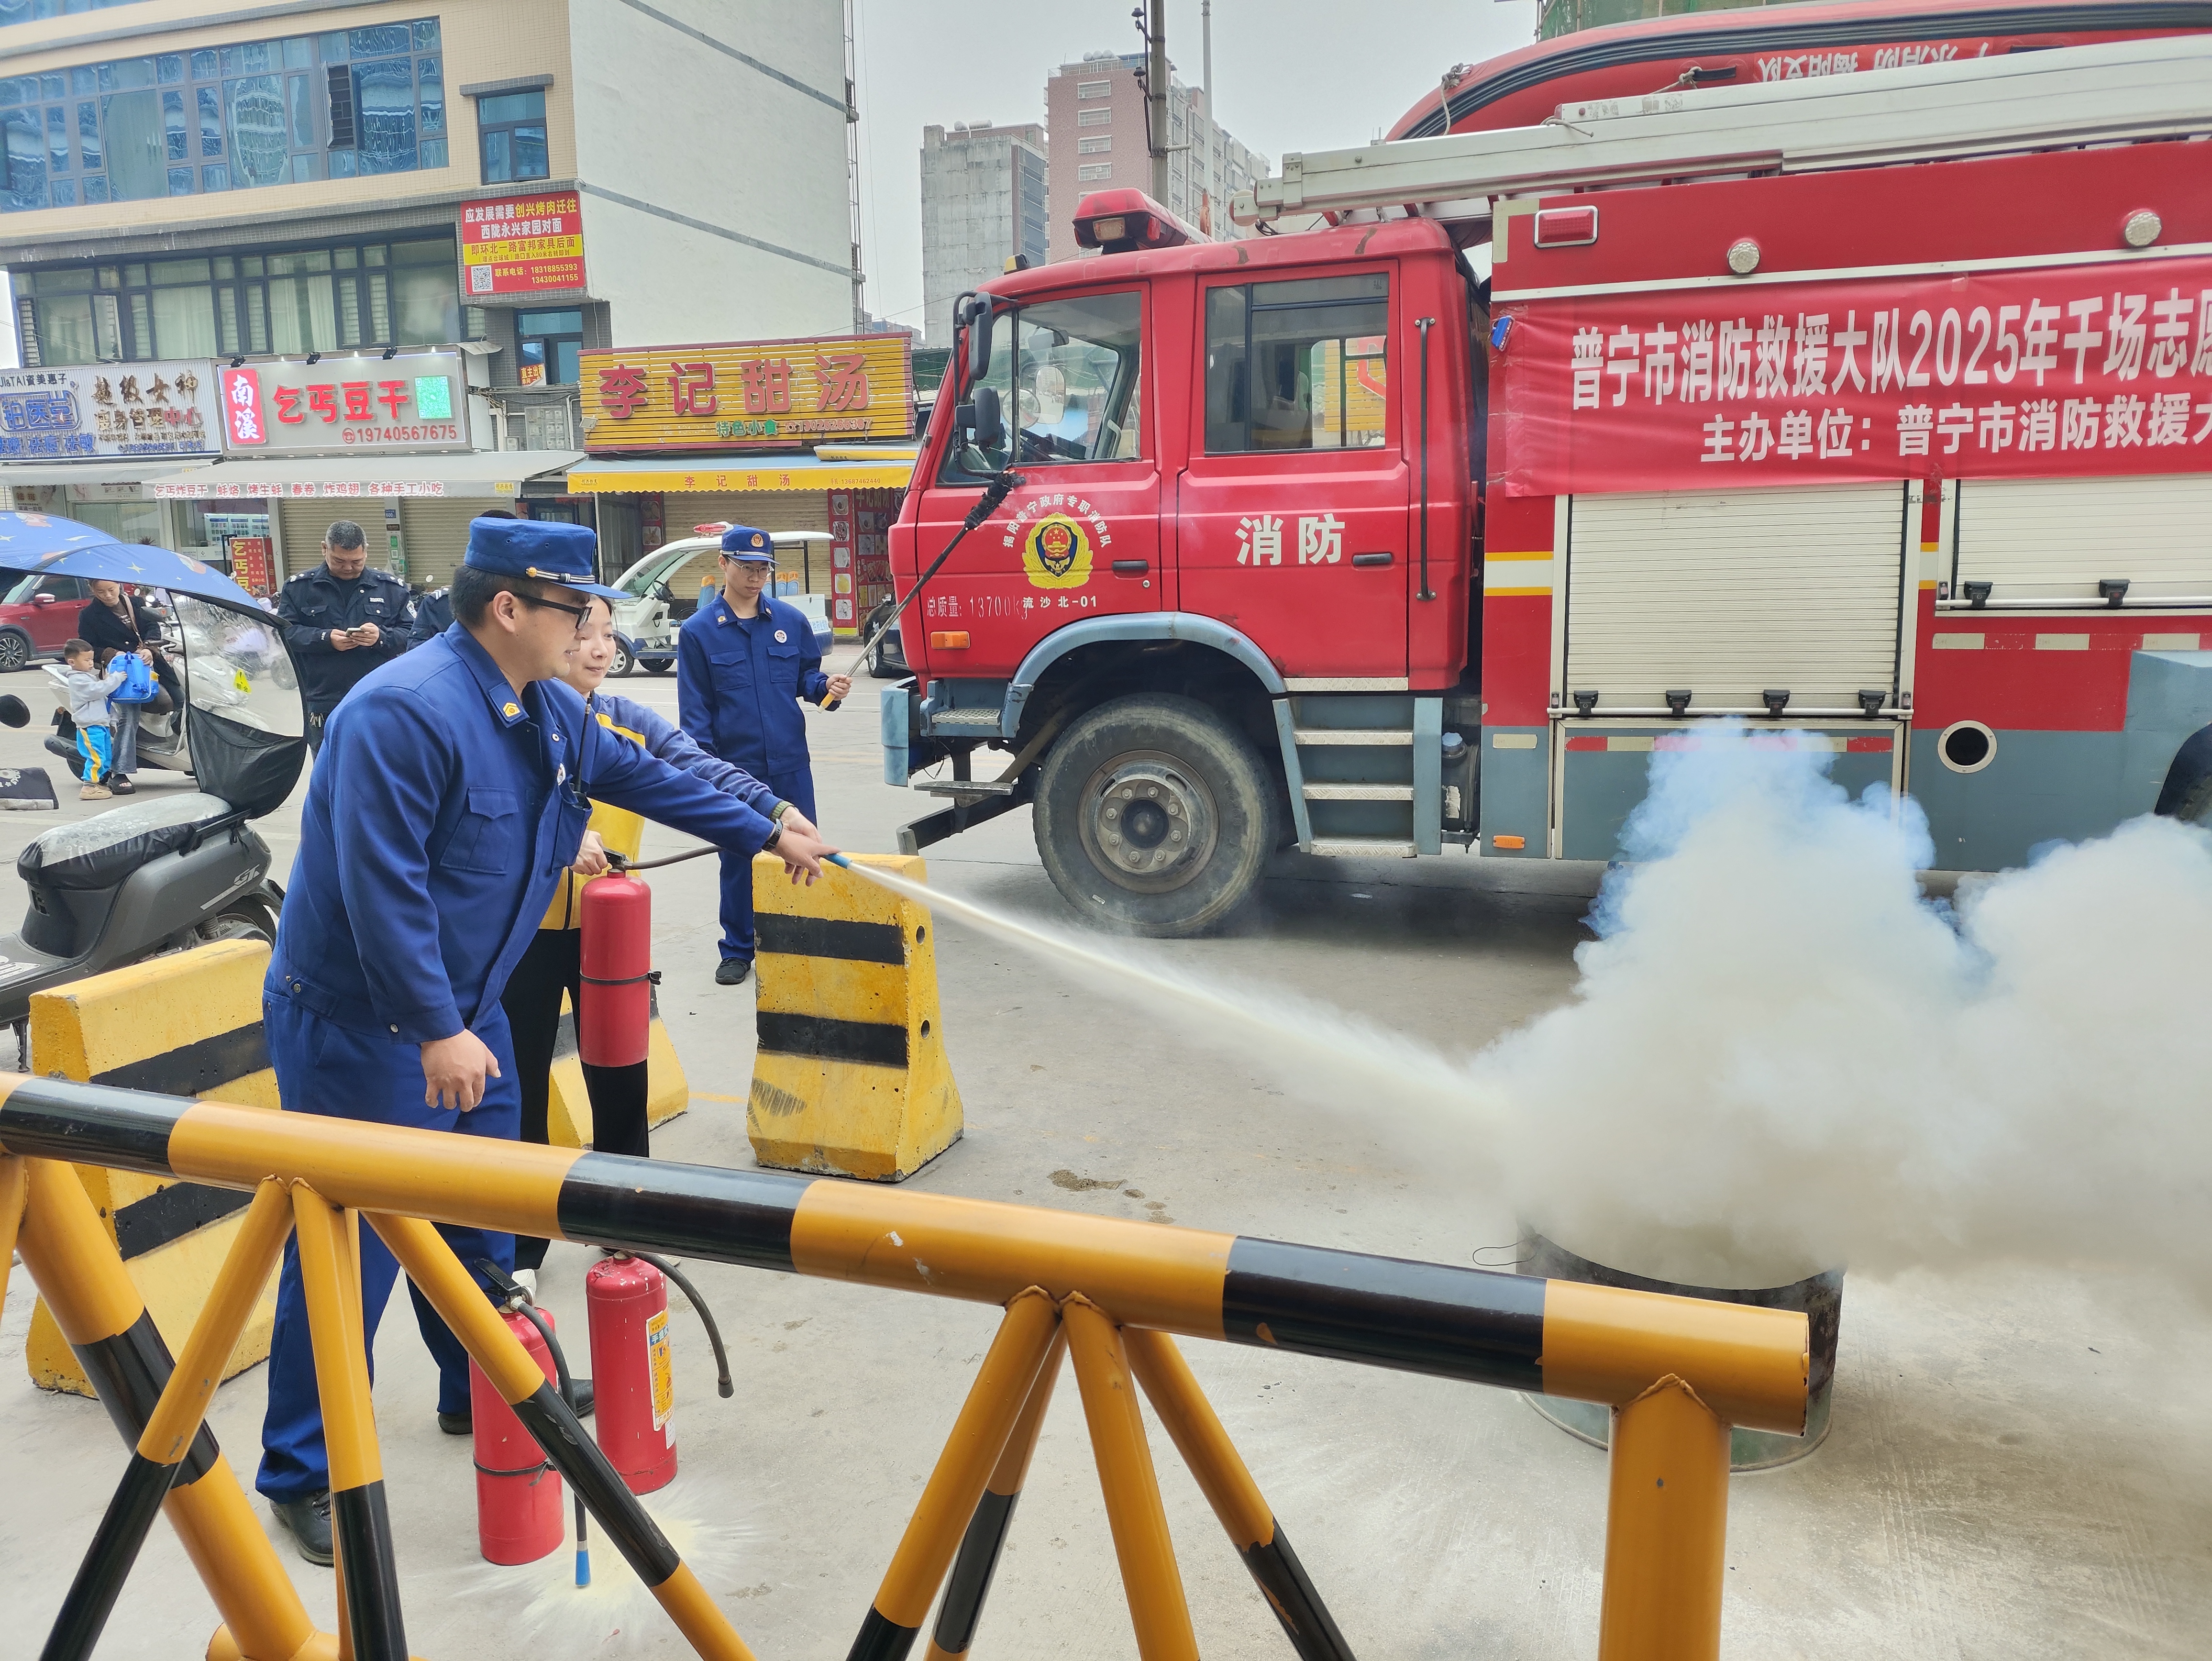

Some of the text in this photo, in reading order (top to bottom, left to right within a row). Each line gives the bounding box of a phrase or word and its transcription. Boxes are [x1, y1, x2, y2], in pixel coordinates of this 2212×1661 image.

[465, 198, 577, 223] 应发展需要创兴烤肉迁往
[481, 218, 562, 239] 西陇永兴家园对面
[471, 236, 575, 256] 即环北一路富邦家具后面
[531, 264, 578, 274] 18318855393
[531, 274, 578, 284] 13430041155
[599, 354, 869, 419] 李记甜汤
[231, 375, 260, 439] 南溪
[273, 380, 409, 424] 乞丐豆干
[357, 425, 457, 442] 19740567675
[716, 419, 778, 436] 特色小食
[155, 481, 444, 497] 乞丐炸豆干 蚝烙 烤生蚝 春卷 炸鸡翅 各种手工小吃
[685, 474, 791, 488] 李记甜汤
[1003, 493, 1112, 548] 揭阳普宁政府专职消防队
[1235, 513, 1345, 565] 消防
[1023, 596, 1097, 609] 流沙北-01
